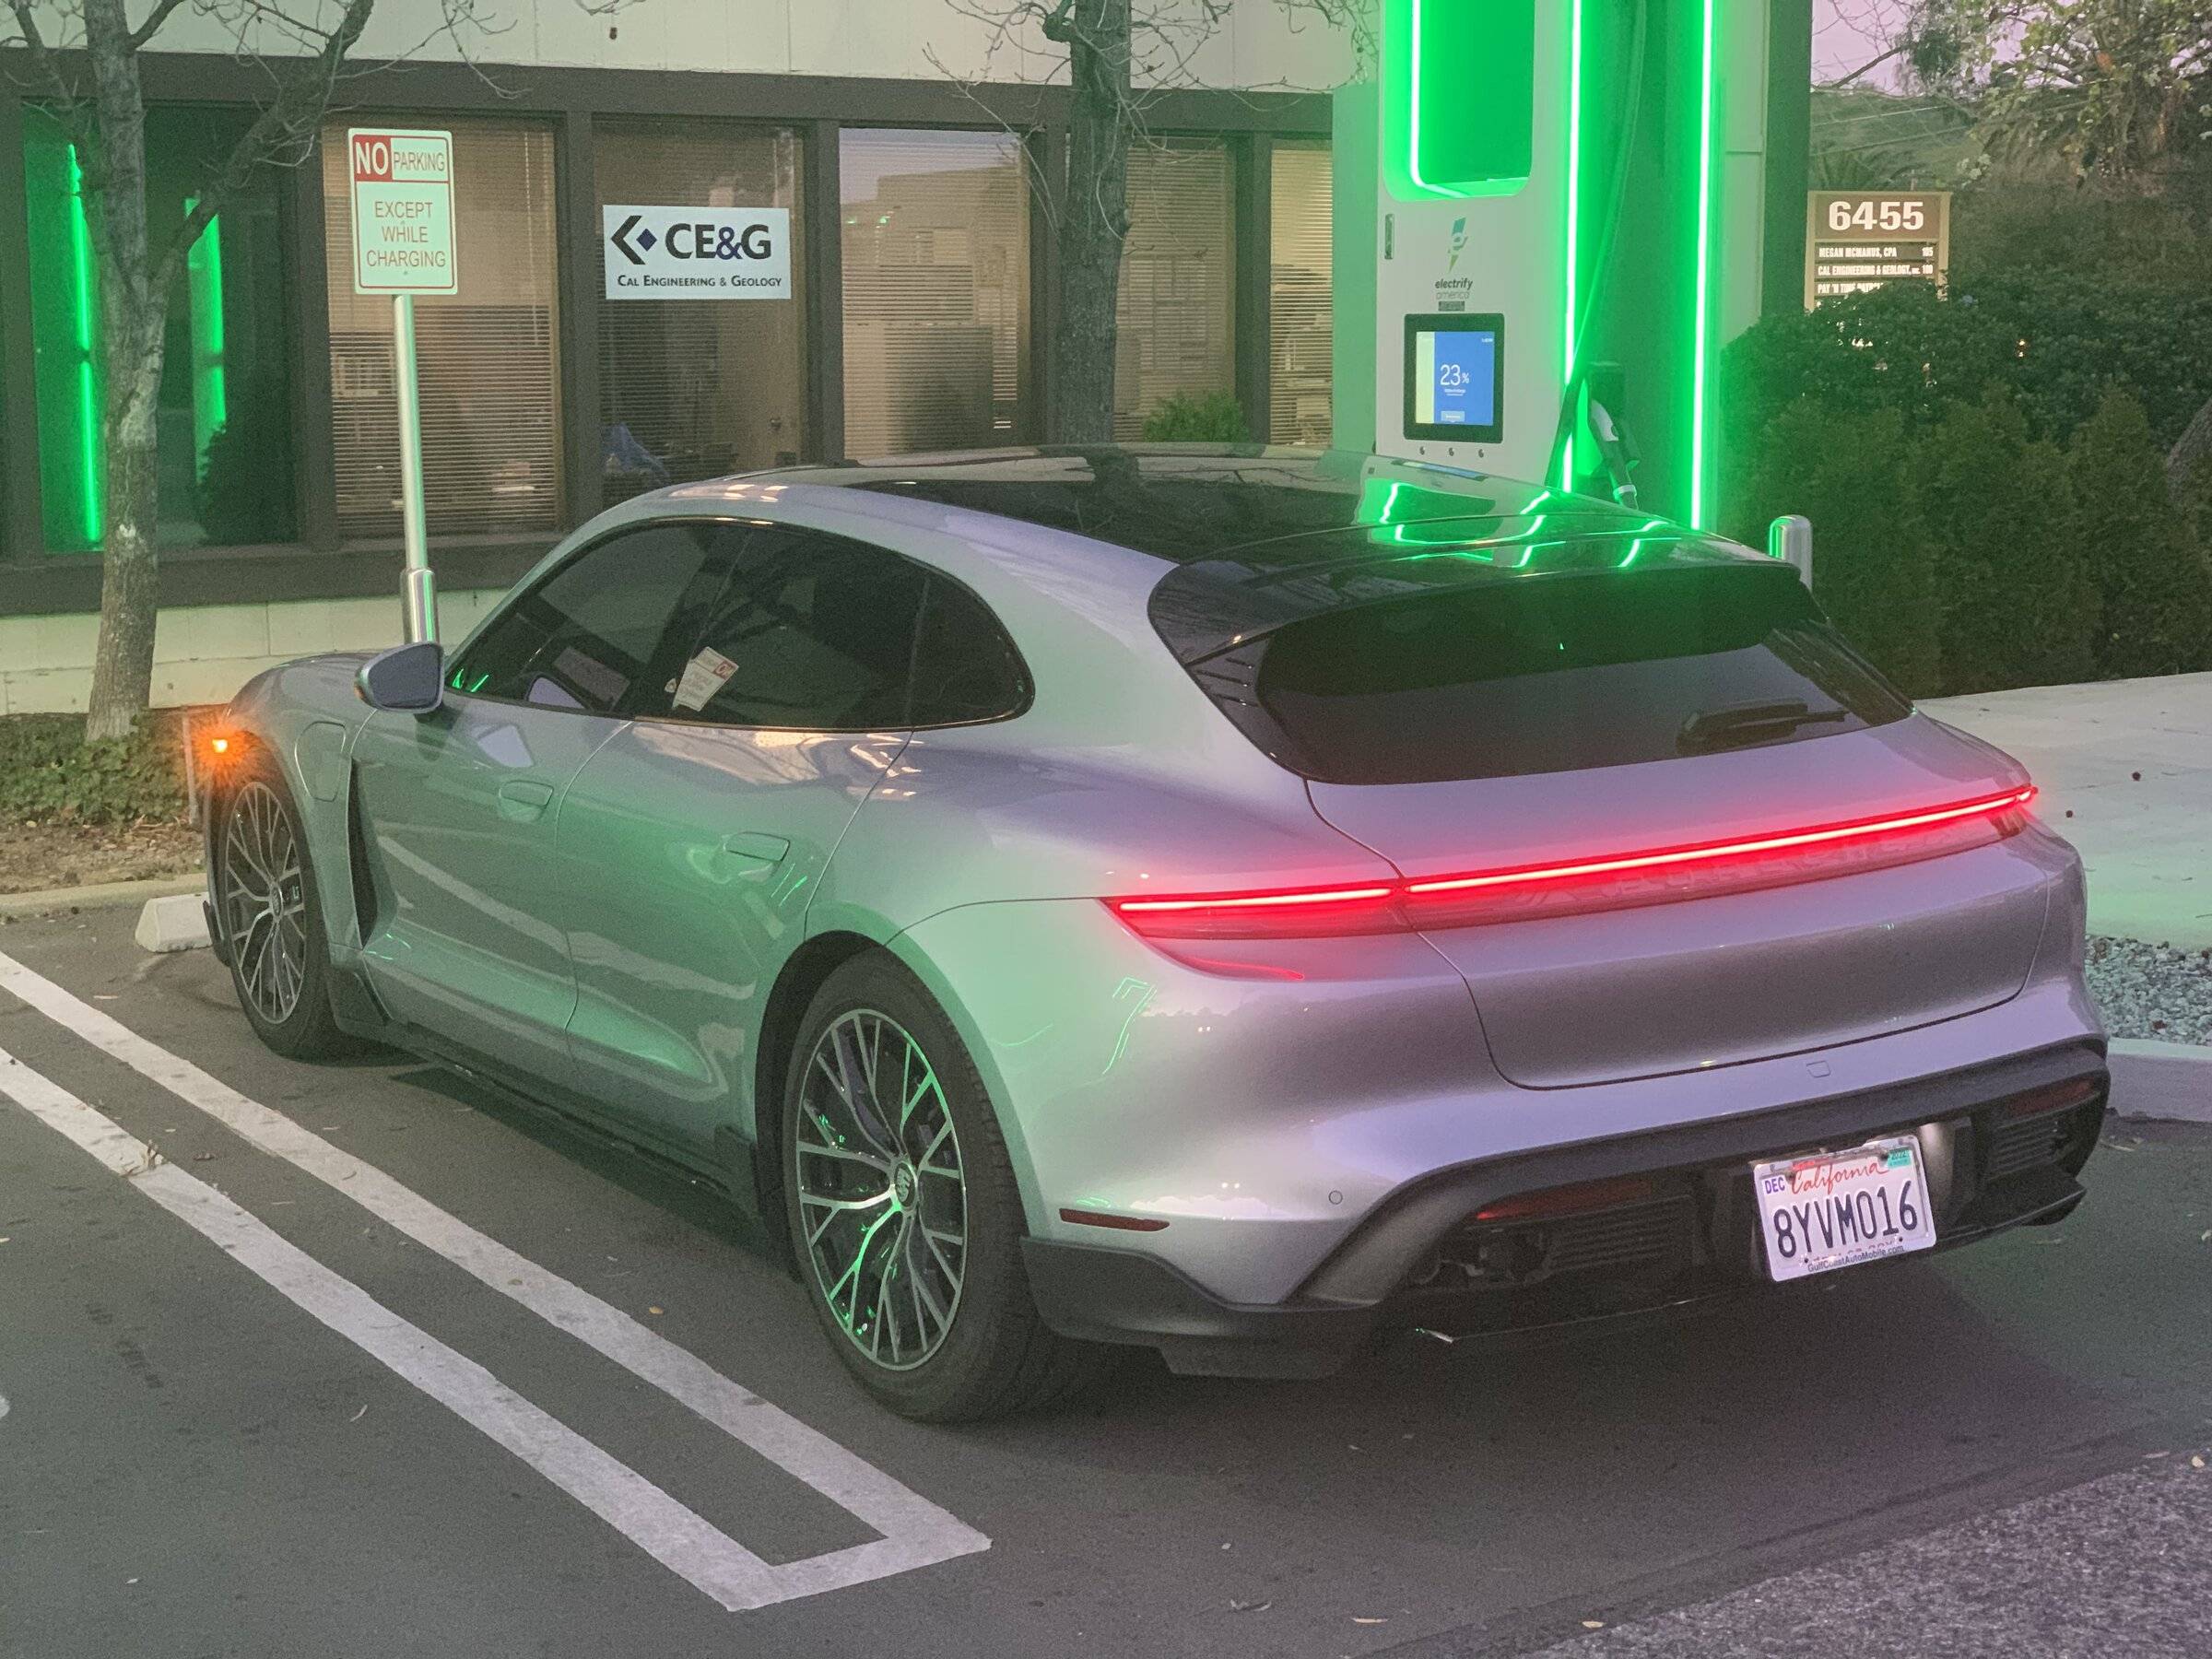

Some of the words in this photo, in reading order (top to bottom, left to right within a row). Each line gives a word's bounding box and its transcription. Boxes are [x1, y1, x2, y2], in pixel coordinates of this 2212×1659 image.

[355, 141, 389, 175] NO
[394, 151, 445, 171] PARKING
[374, 201, 433, 218] EXCEPT
[1829, 201, 1924, 230] 6455
[382, 226, 429, 243] WHILE
[665, 223, 771, 260] CE&G
[366, 250, 446, 268] CHARGING
[1883, 246, 1898, 258] CPA
[1818, 265, 1830, 276] CAL
[1832, 265, 1876, 276] ENGINEERING
[1876, 265, 1881, 276] &
[643, 275, 716, 287] ENGINEERING
[720, 276, 726, 287] &
[731, 276, 782, 287] GEOLOGY
[1434, 277, 1473, 290] electrify
[1818, 283, 1830, 294] PAY
[1764, 1177, 1786, 1194] DEC
[1791, 1161, 1890, 1195] California
[1772, 1180, 1919, 1259] 8YVM016
